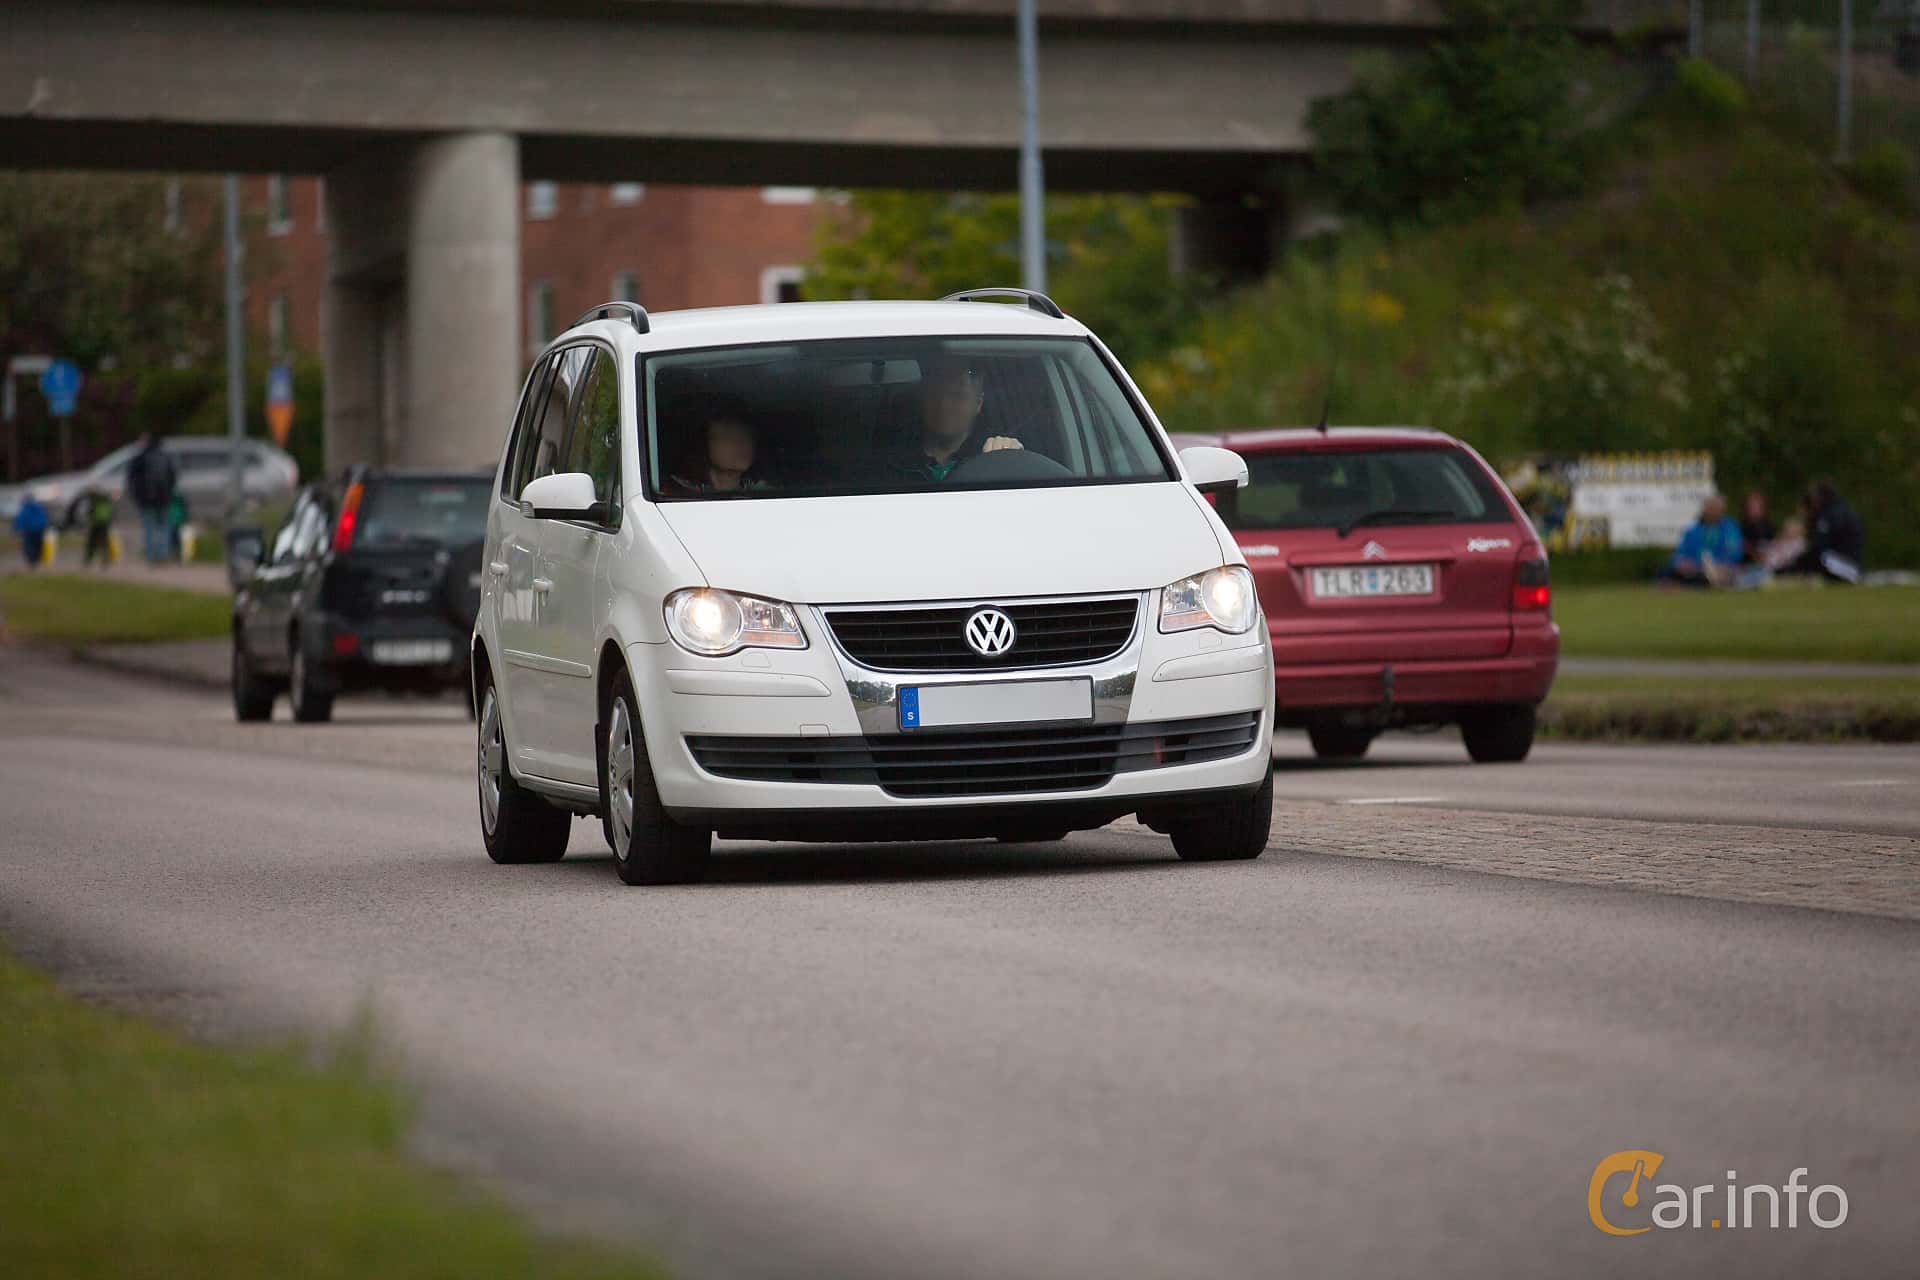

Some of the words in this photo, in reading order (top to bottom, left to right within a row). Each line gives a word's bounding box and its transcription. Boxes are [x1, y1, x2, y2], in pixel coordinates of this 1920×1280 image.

[1321, 570, 1364, 594] TLR
[1383, 567, 1426, 592] 263
[966, 610, 1015, 656] VW
[907, 711, 915, 721] S
